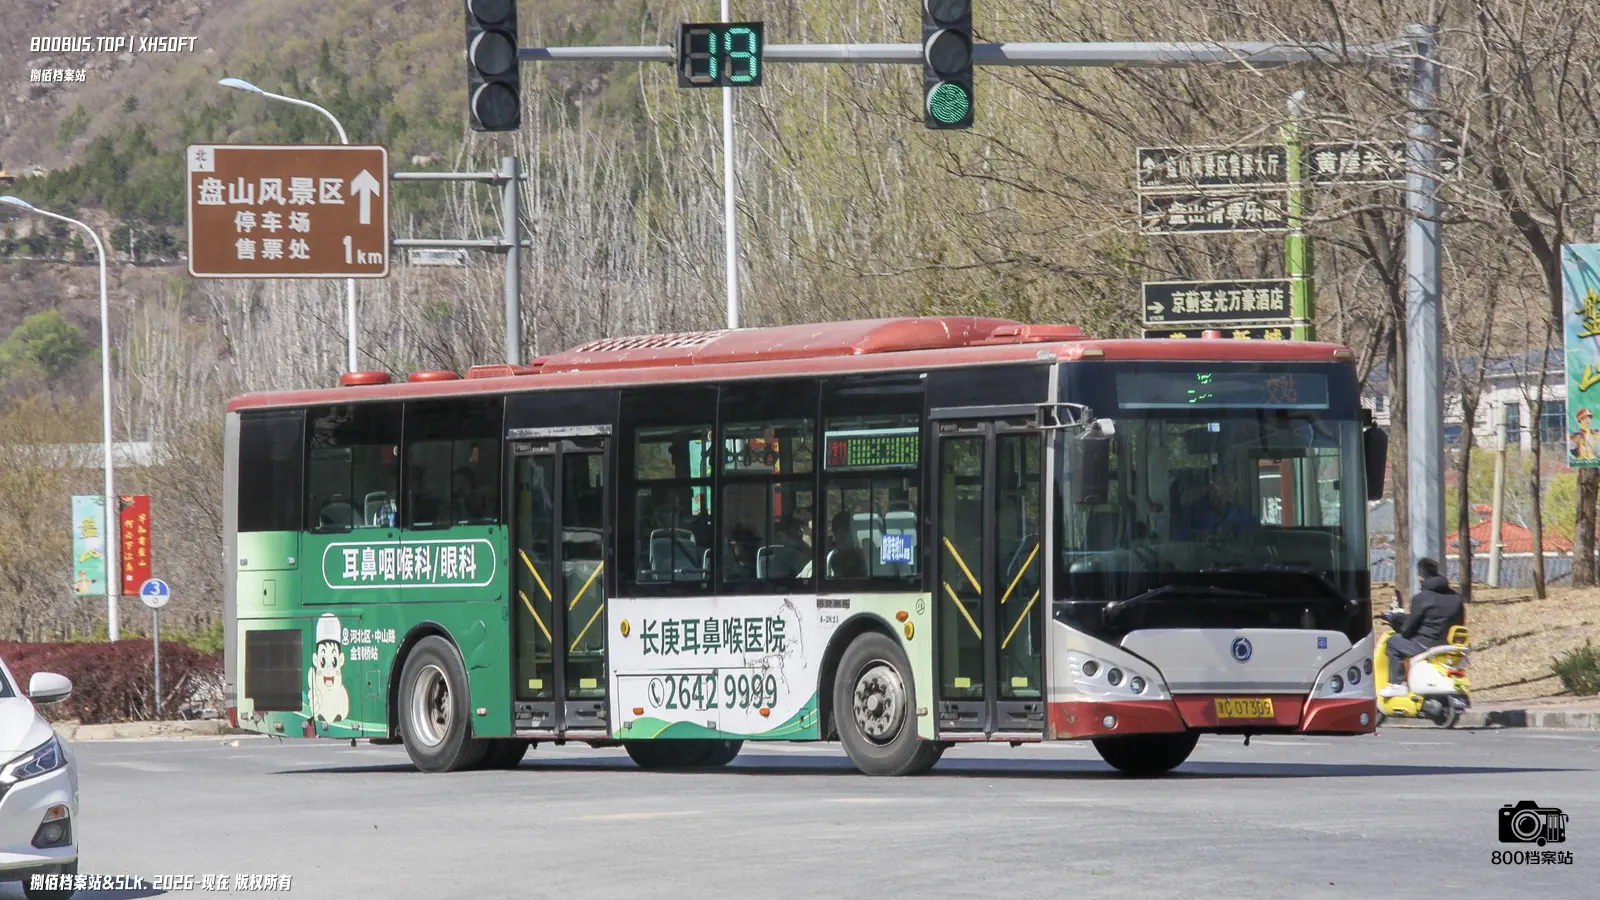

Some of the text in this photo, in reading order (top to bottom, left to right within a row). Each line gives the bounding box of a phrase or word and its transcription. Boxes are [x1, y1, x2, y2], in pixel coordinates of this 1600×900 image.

[709, 28, 757, 82] 19
[195, 149, 207, 162] 北
[198, 177, 345, 206] 盘山风景区
[234, 211, 311, 233] 停车场
[234, 238, 311, 260] 售票处
[1171, 288, 1284, 314] 京蓟圣光万豪酒店
[342, 544, 477, 583] 耳鼻咽喉科/眼科
[149, 581, 161, 595] 3
[639, 615, 786, 656] 长庚耳鼻喉医院
[664, 674, 777, 710] 2642 9999
